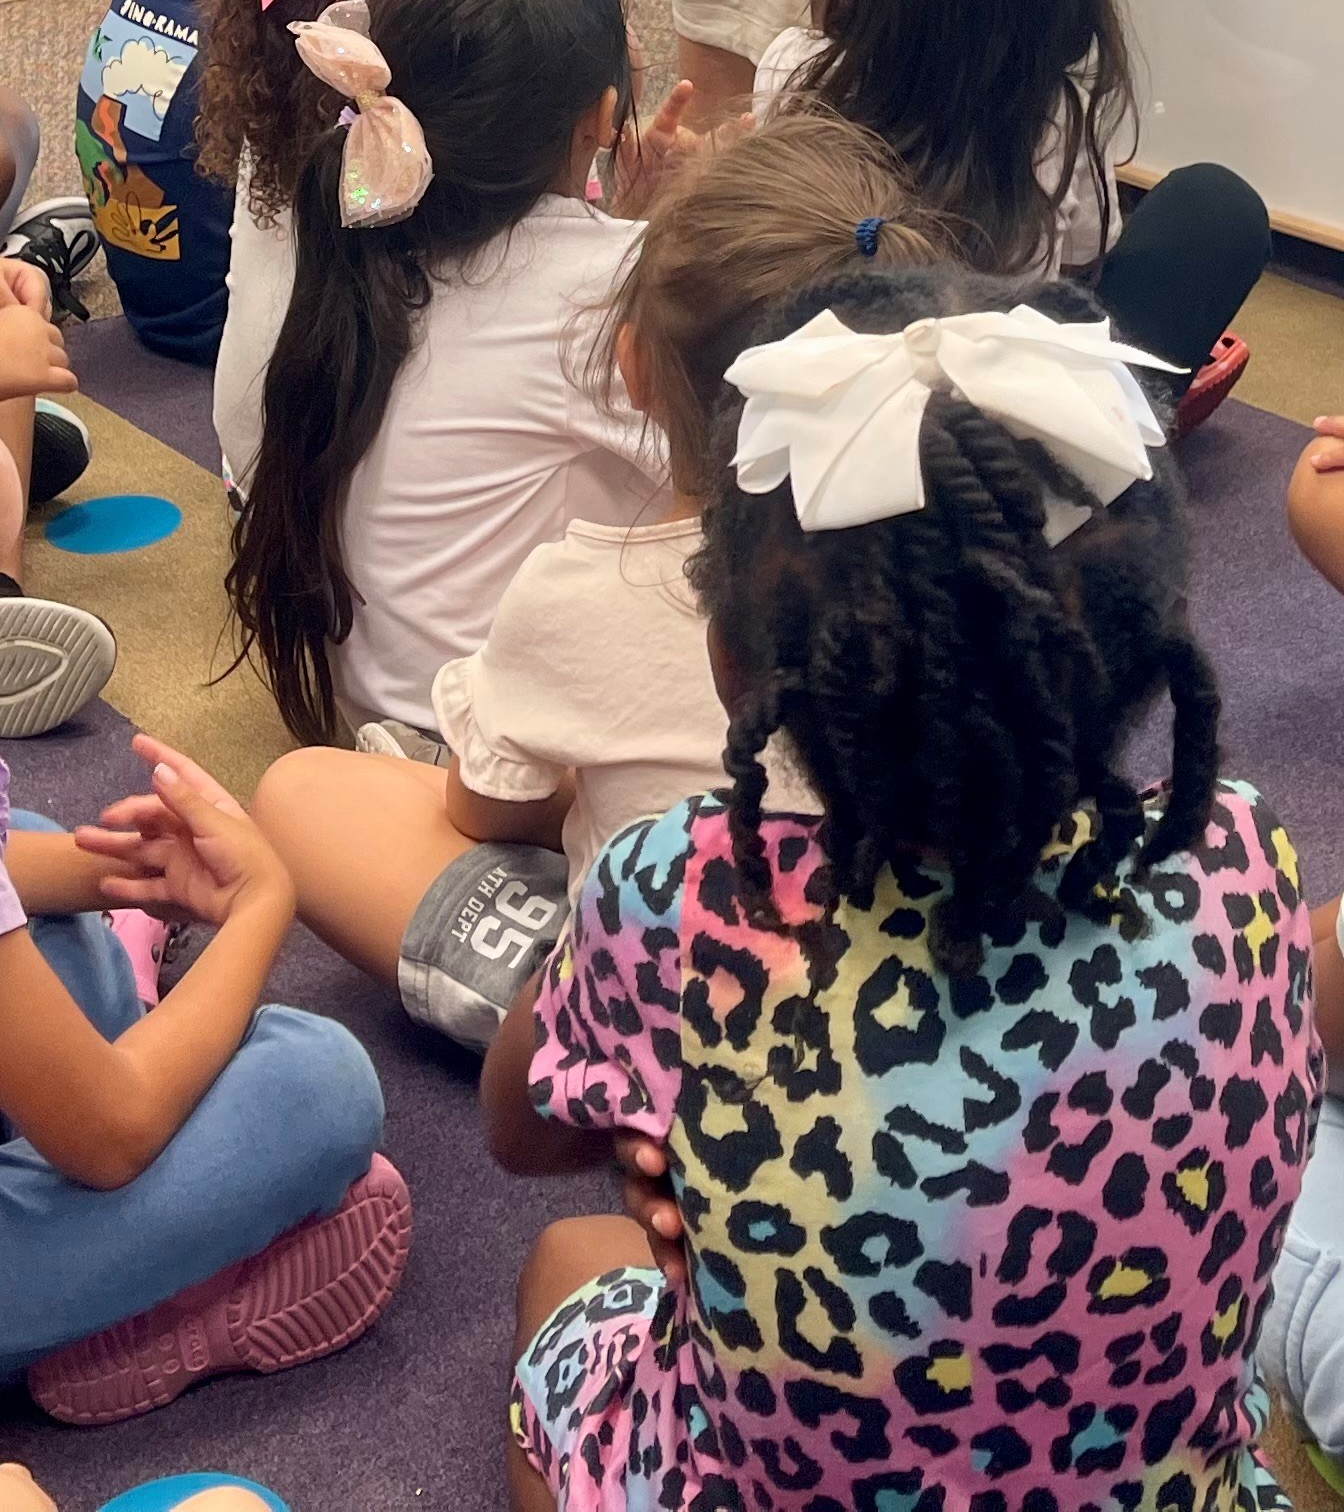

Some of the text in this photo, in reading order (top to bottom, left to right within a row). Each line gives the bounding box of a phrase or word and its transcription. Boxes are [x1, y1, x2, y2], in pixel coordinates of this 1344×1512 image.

[451, 867, 508, 943] ATH DEPT
[470, 880, 557, 969] 95
